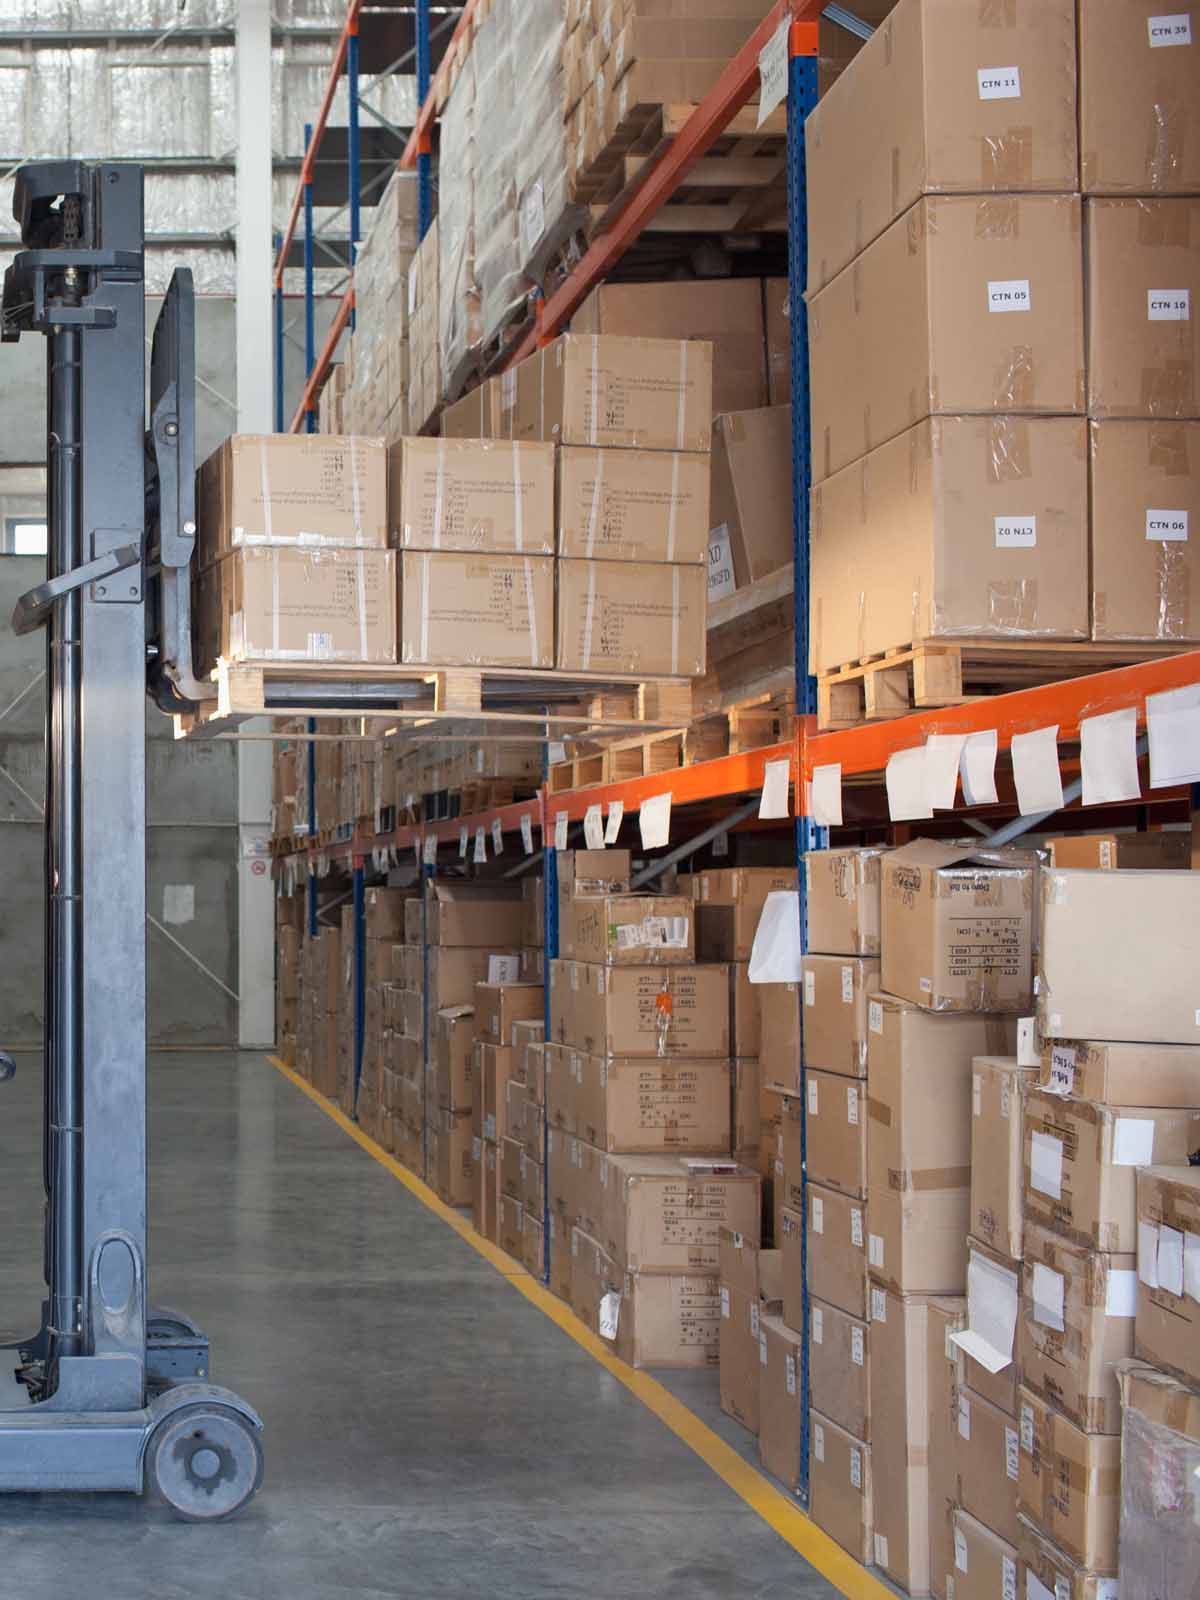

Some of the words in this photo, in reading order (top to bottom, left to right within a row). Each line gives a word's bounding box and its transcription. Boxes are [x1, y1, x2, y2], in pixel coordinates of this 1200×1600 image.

[1151, 27, 1172, 36] CTN
[981, 80, 1001, 88] CTN
[991, 292, 1011, 301] CTN
[1014, 292, 1027, 300] 05
[1173, 301, 1186, 309] 10
[1149, 521, 1169, 530] CTN
[1172, 522, 1185, 530] 06
[998, 528, 1010, 536] 02
[1014, 528, 1033, 536] CTN
